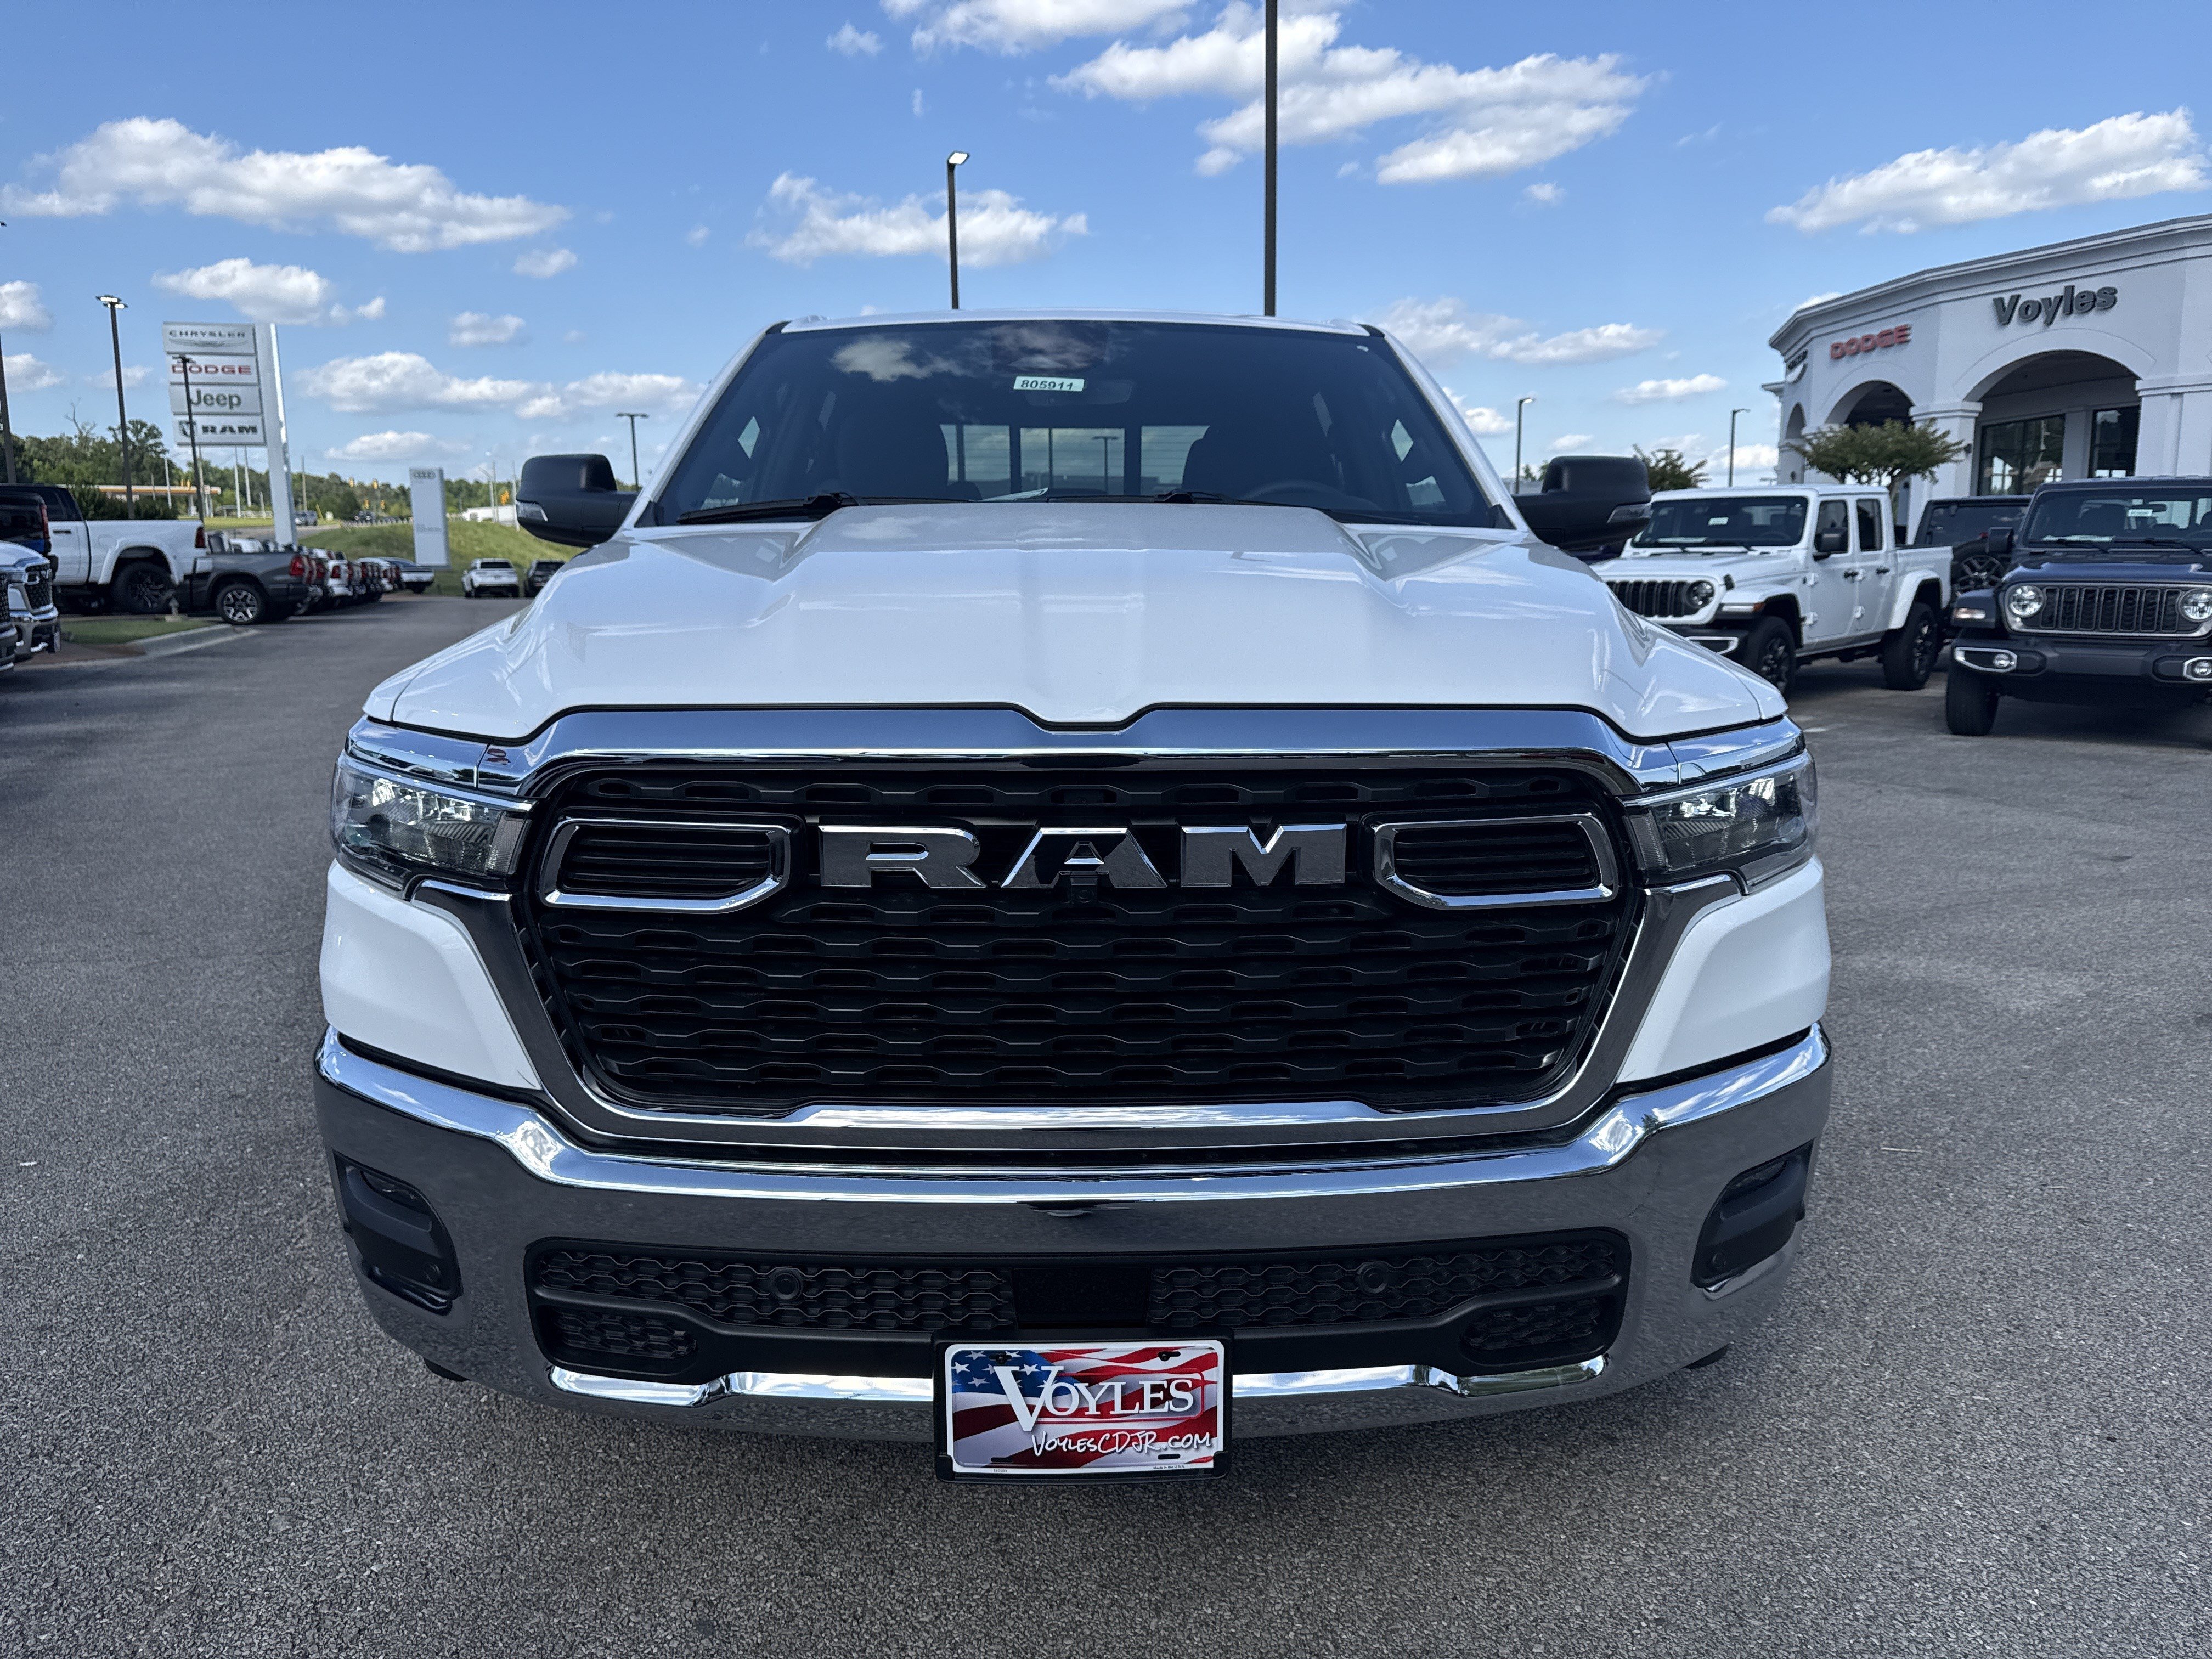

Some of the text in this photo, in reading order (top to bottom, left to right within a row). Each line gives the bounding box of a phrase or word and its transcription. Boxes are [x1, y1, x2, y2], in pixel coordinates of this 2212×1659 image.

[1993, 285, 2118, 326] Voyles
[169, 330, 245, 338] CHRYSLER
[1830, 324, 1912, 359] DODGE
[171, 364, 251, 375] DODGE
[1021, 380, 1074, 390] 805911
[190, 388, 242, 410] Jeep
[202, 425, 257, 435] RAM
[817, 823, 1347, 888] RAM
[993, 1365, 1194, 1432] VOYLES
